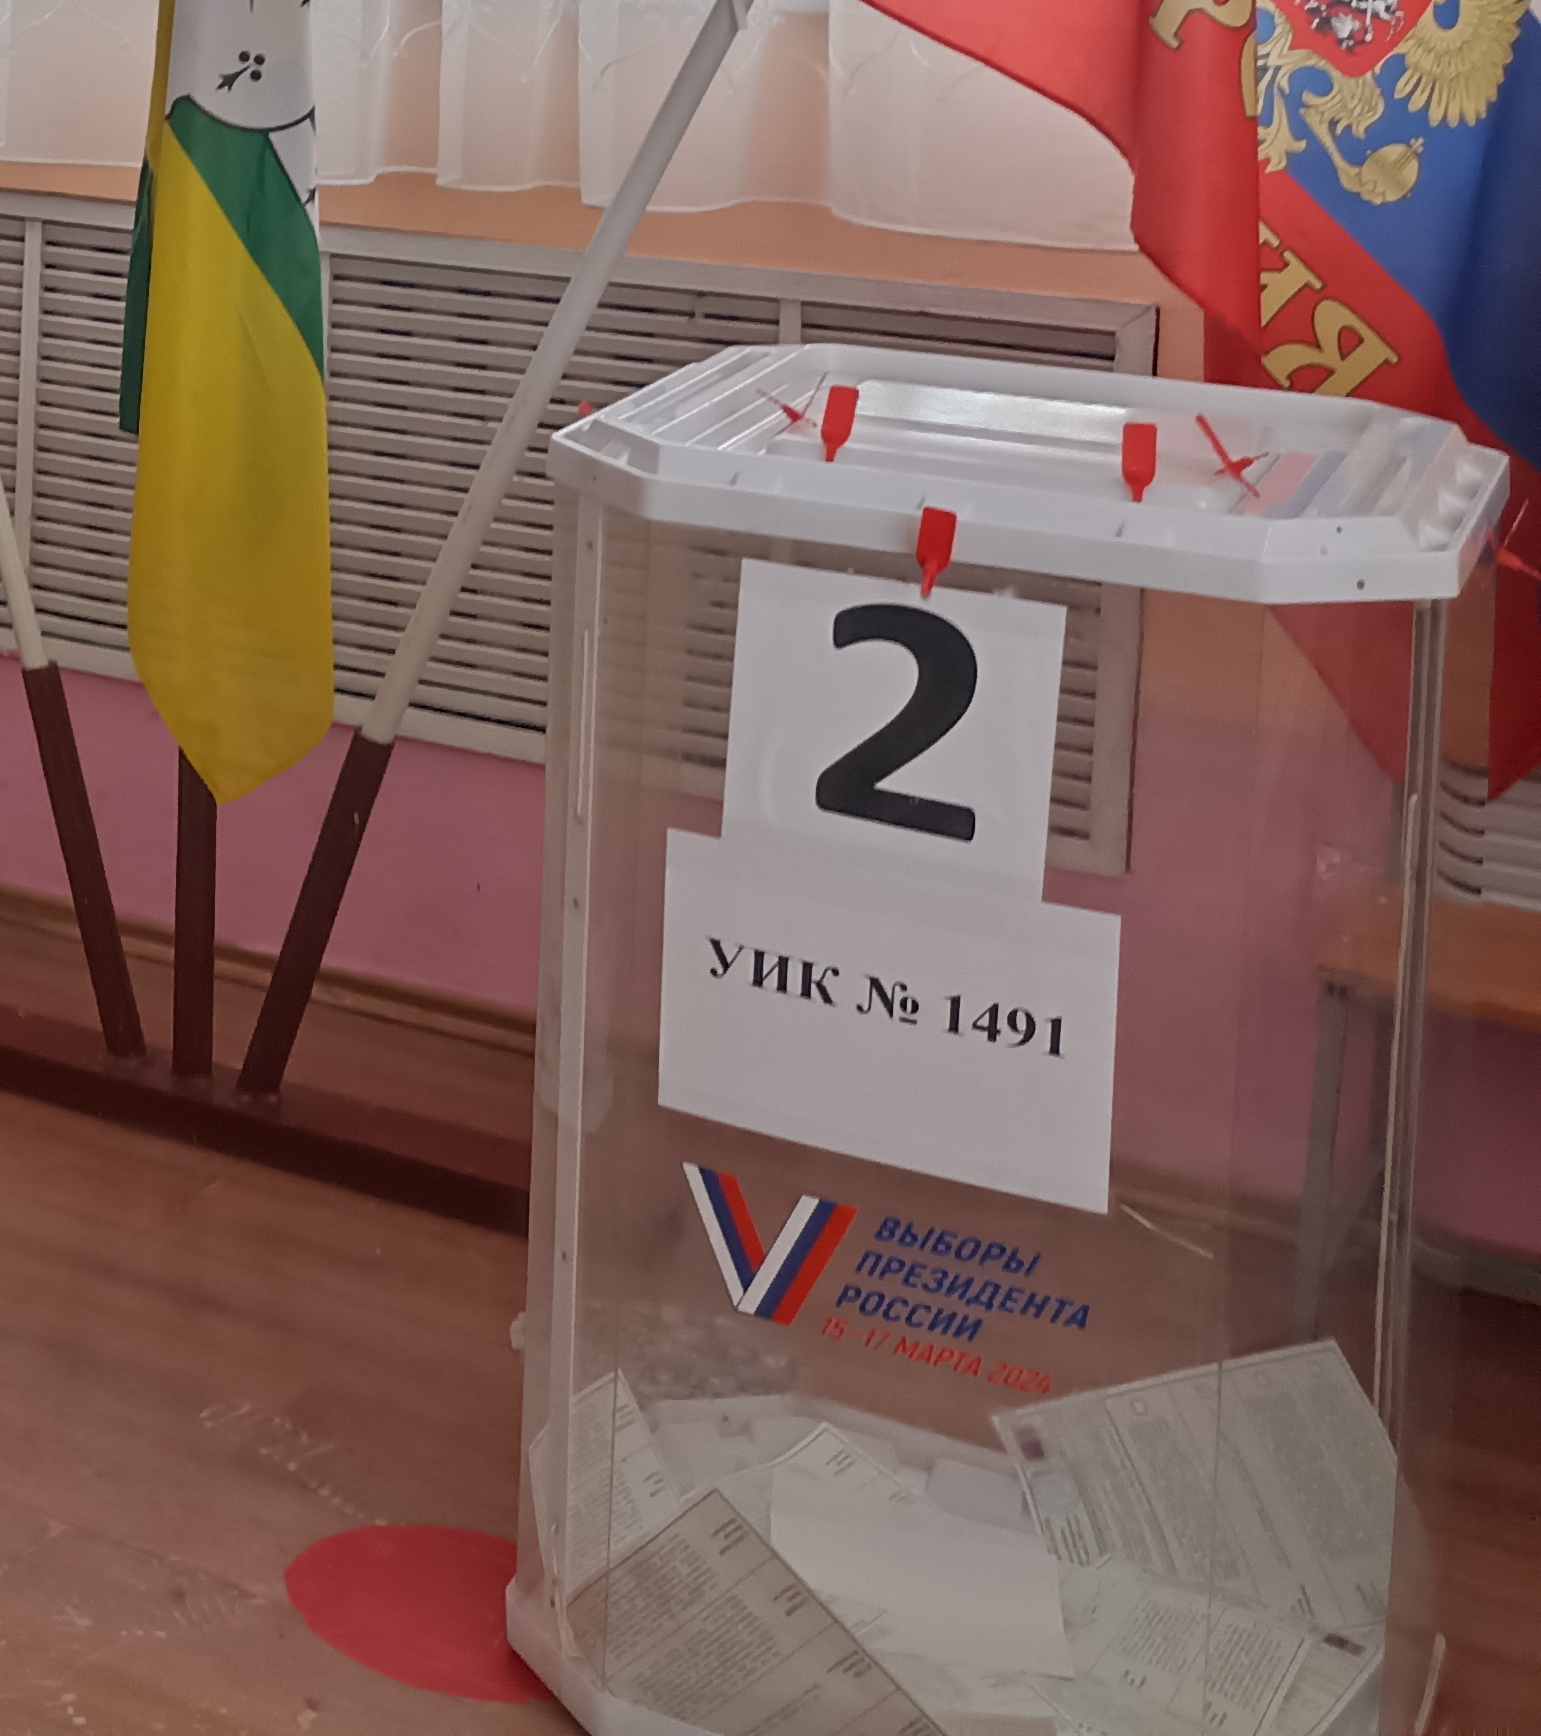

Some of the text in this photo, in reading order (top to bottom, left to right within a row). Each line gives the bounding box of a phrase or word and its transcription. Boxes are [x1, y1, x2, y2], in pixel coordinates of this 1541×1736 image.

[815, 603, 978, 843] 2
[706, 934, 1065, 1058] УИК № 1491
[875, 1217, 1041, 1277] ВЫБОРЫ
[836, 1285, 984, 1342] РОССИИ
[855, 1251, 1090, 1330] ПРЕЗИДЕНТА
[893, 1336, 984, 1378] МАРТА
[987, 1361, 1053, 1394] 2024
